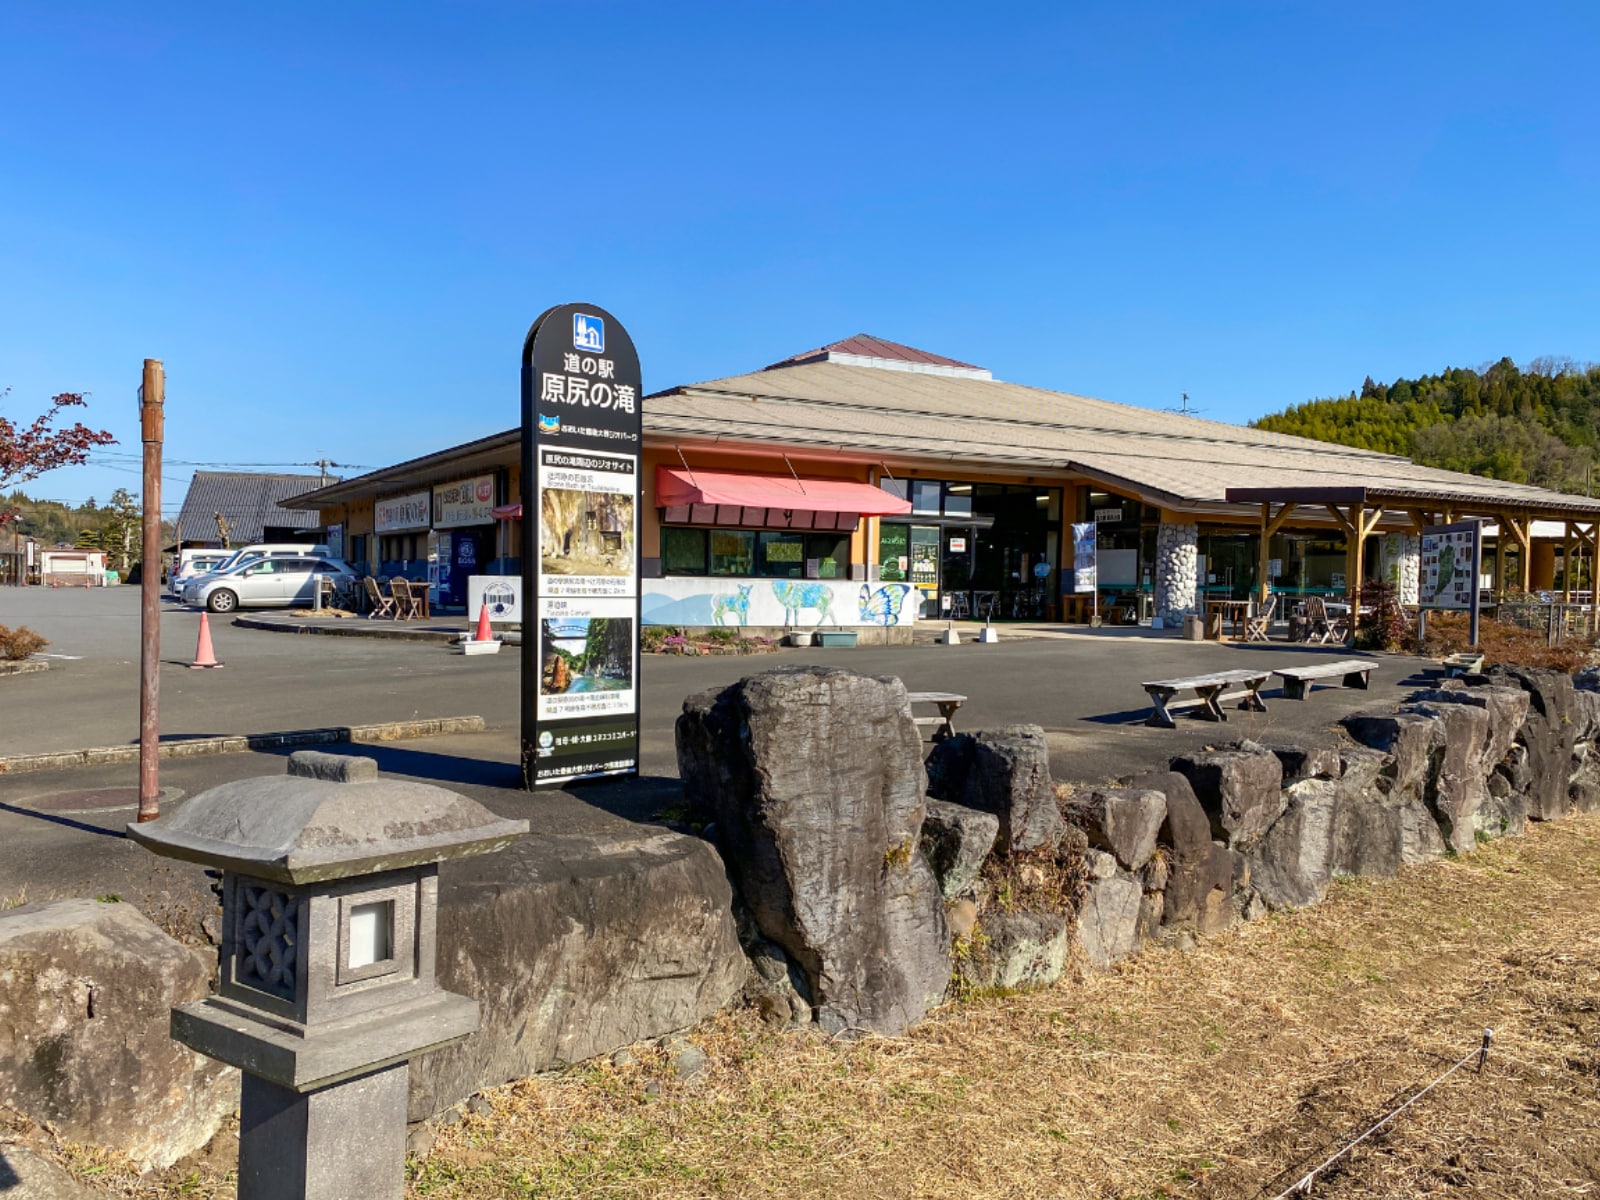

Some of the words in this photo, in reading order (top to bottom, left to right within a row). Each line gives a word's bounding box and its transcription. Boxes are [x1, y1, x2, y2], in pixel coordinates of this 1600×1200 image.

[563, 352, 615, 380] 道の駅
[541, 372, 636, 414] 原尻の滝
